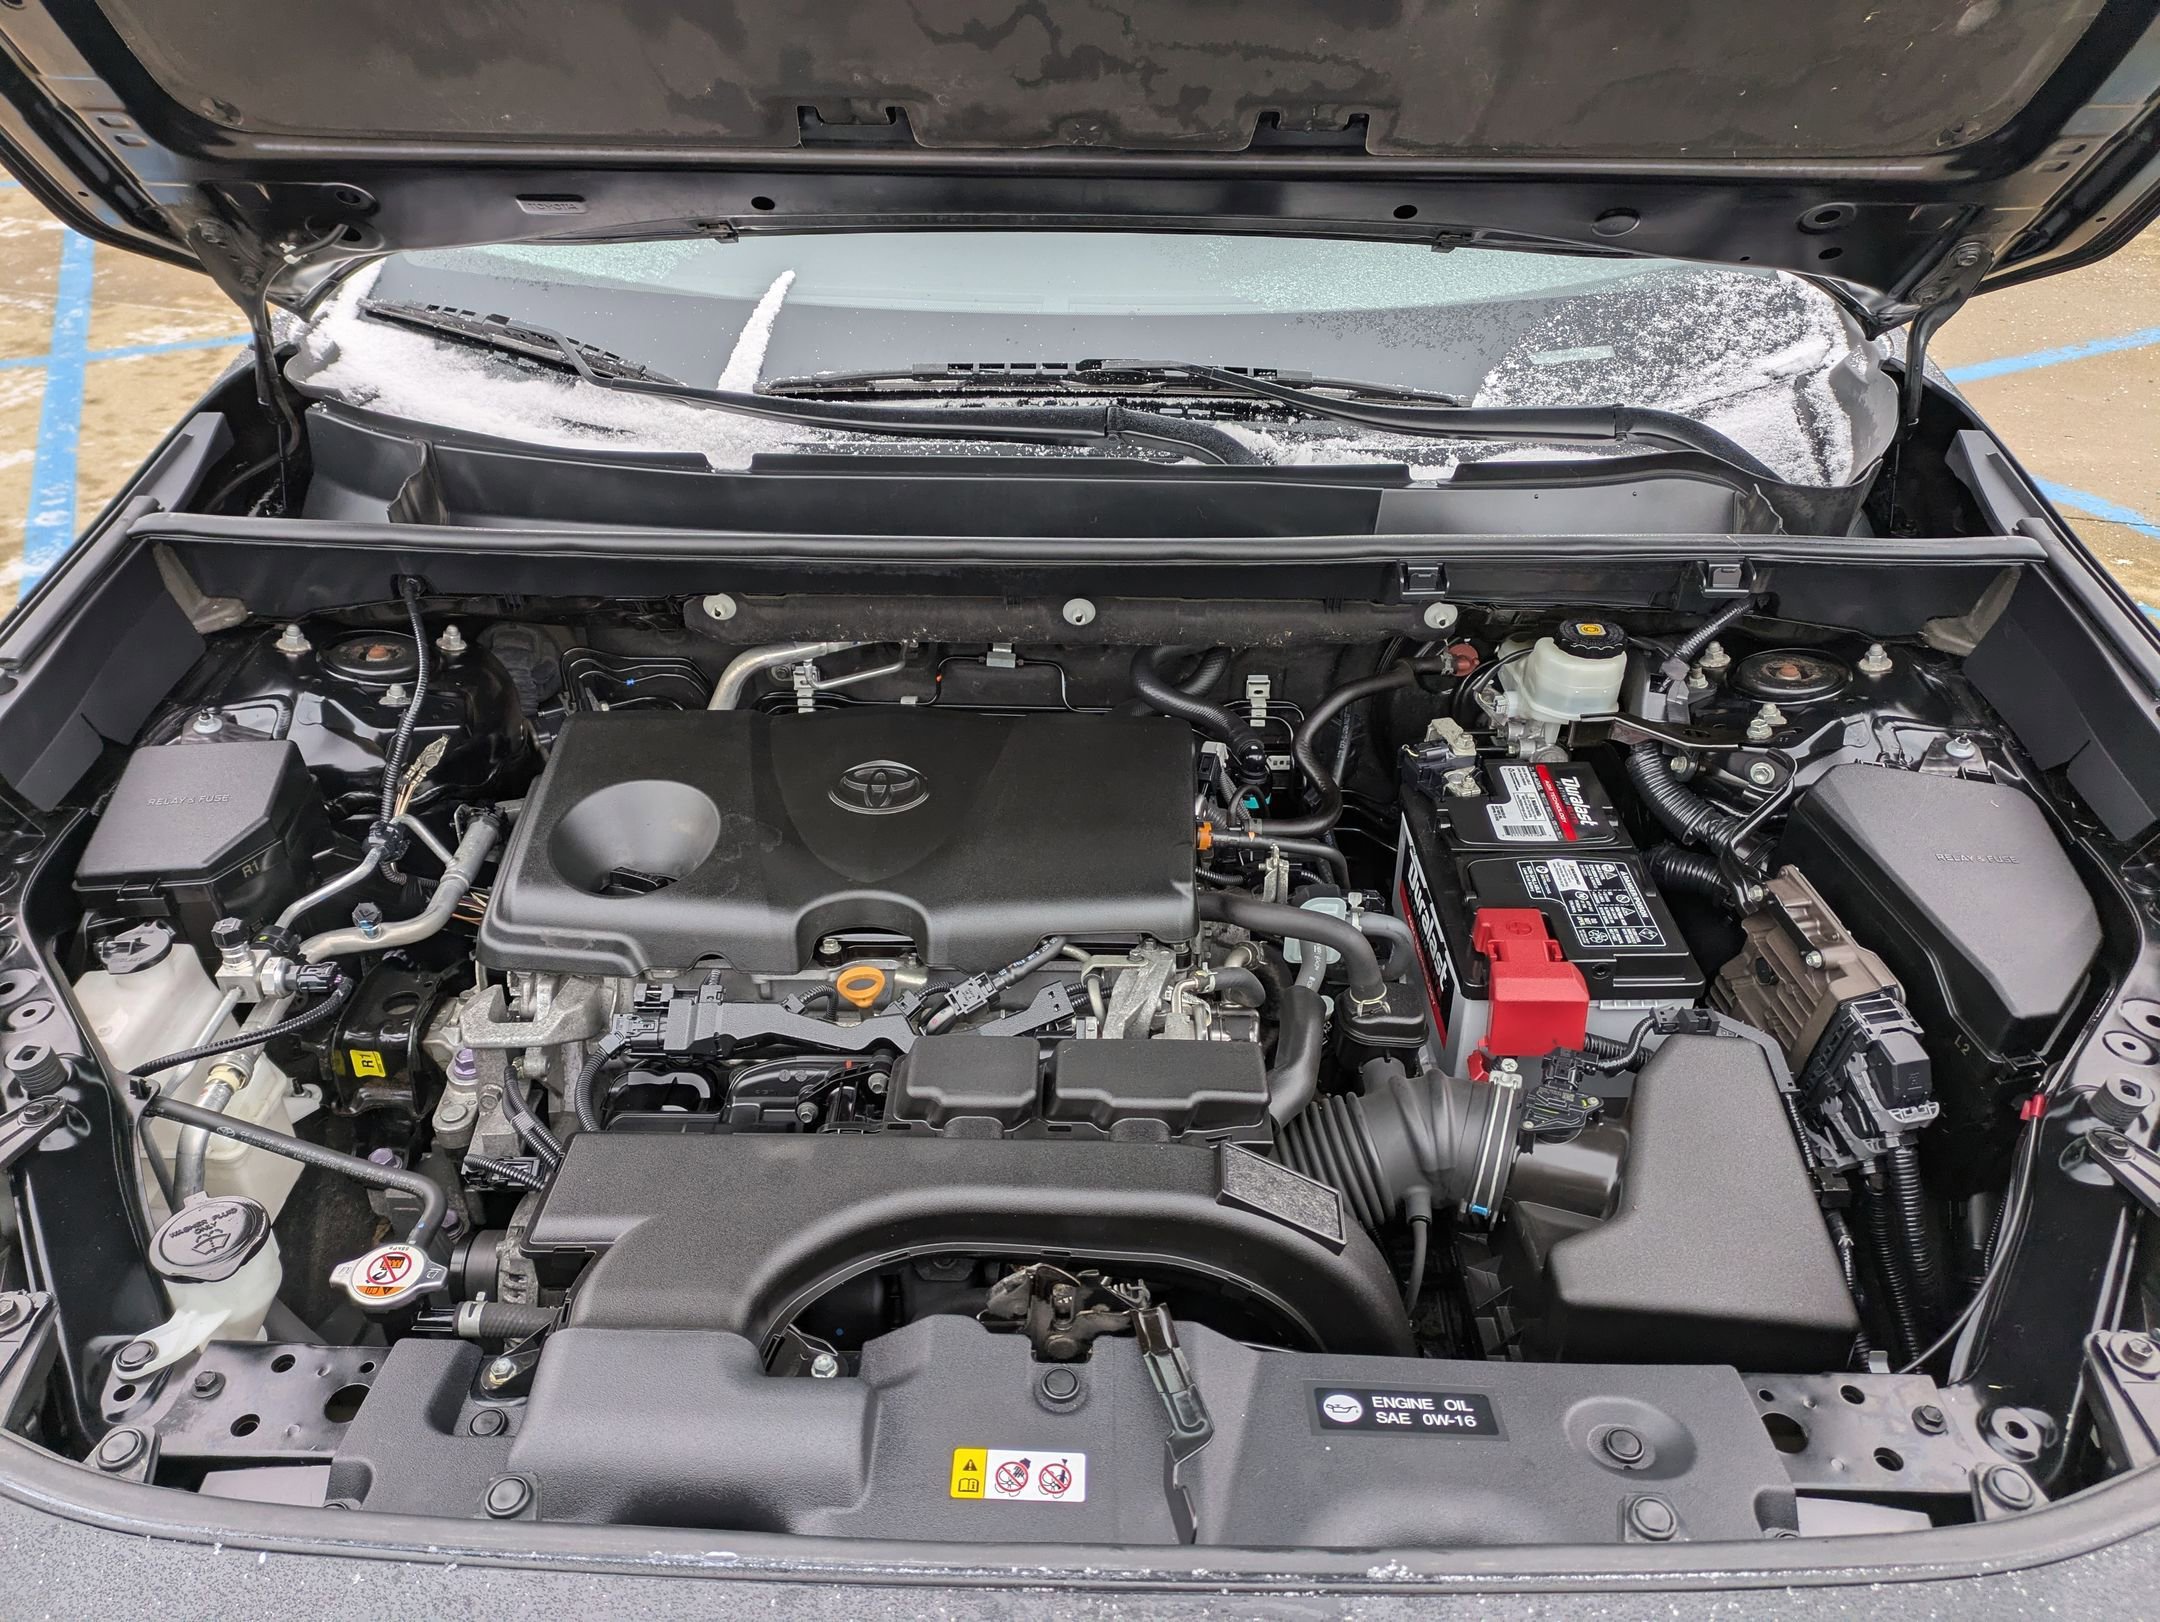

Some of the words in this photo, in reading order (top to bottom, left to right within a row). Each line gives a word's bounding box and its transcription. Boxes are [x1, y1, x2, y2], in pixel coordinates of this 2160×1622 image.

[527, 202, 578, 211] TOYOTA
[146, 796, 187, 806] RELAY
[198, 793, 230, 803] FUSE
[1560, 776, 1599, 827] Duralast
[1935, 853, 1974, 863] RELAY
[1987, 855, 2020, 864] FUSE
[241, 860, 260, 878] R1
[1408, 850, 1448, 992] Duralast
[1953, 1034, 1971, 1057] L2
[361, 1054, 375, 1068] R1
[168, 1219, 208, 1239] WASHER
[211, 1207, 239, 1222] FLUID
[194, 1221, 218, 1235] ONLY
[1371, 1396, 1435, 1411] ENGINE
[1444, 1399, 1474, 1412] OIL
[1375, 1411, 1412, 1425] SAE
[1422, 1413, 1477, 1428] 0W-16
